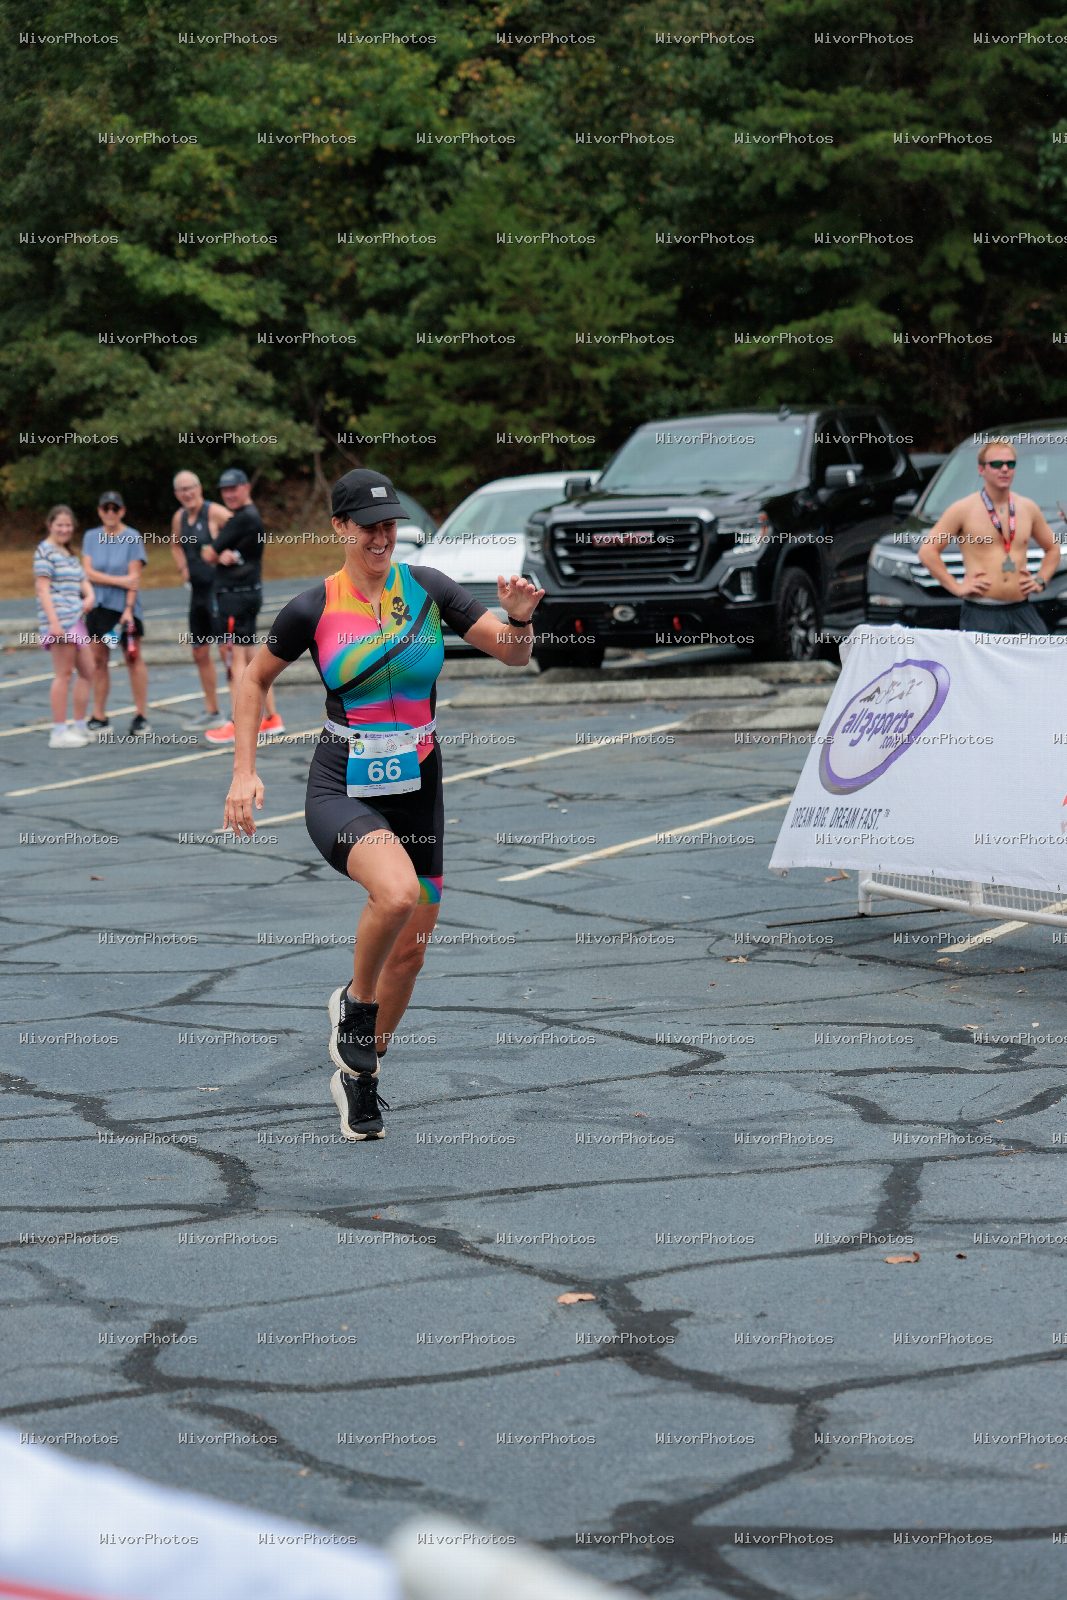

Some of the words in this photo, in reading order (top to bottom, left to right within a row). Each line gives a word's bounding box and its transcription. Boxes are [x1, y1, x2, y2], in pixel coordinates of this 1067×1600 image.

[841, 708, 915, 747] all3sports
[368, 758, 401, 782] 66
[790, 807, 816, 829] DREAM
[829, 807, 860, 829] DREAM
[857, 808, 883, 830] FAST.
